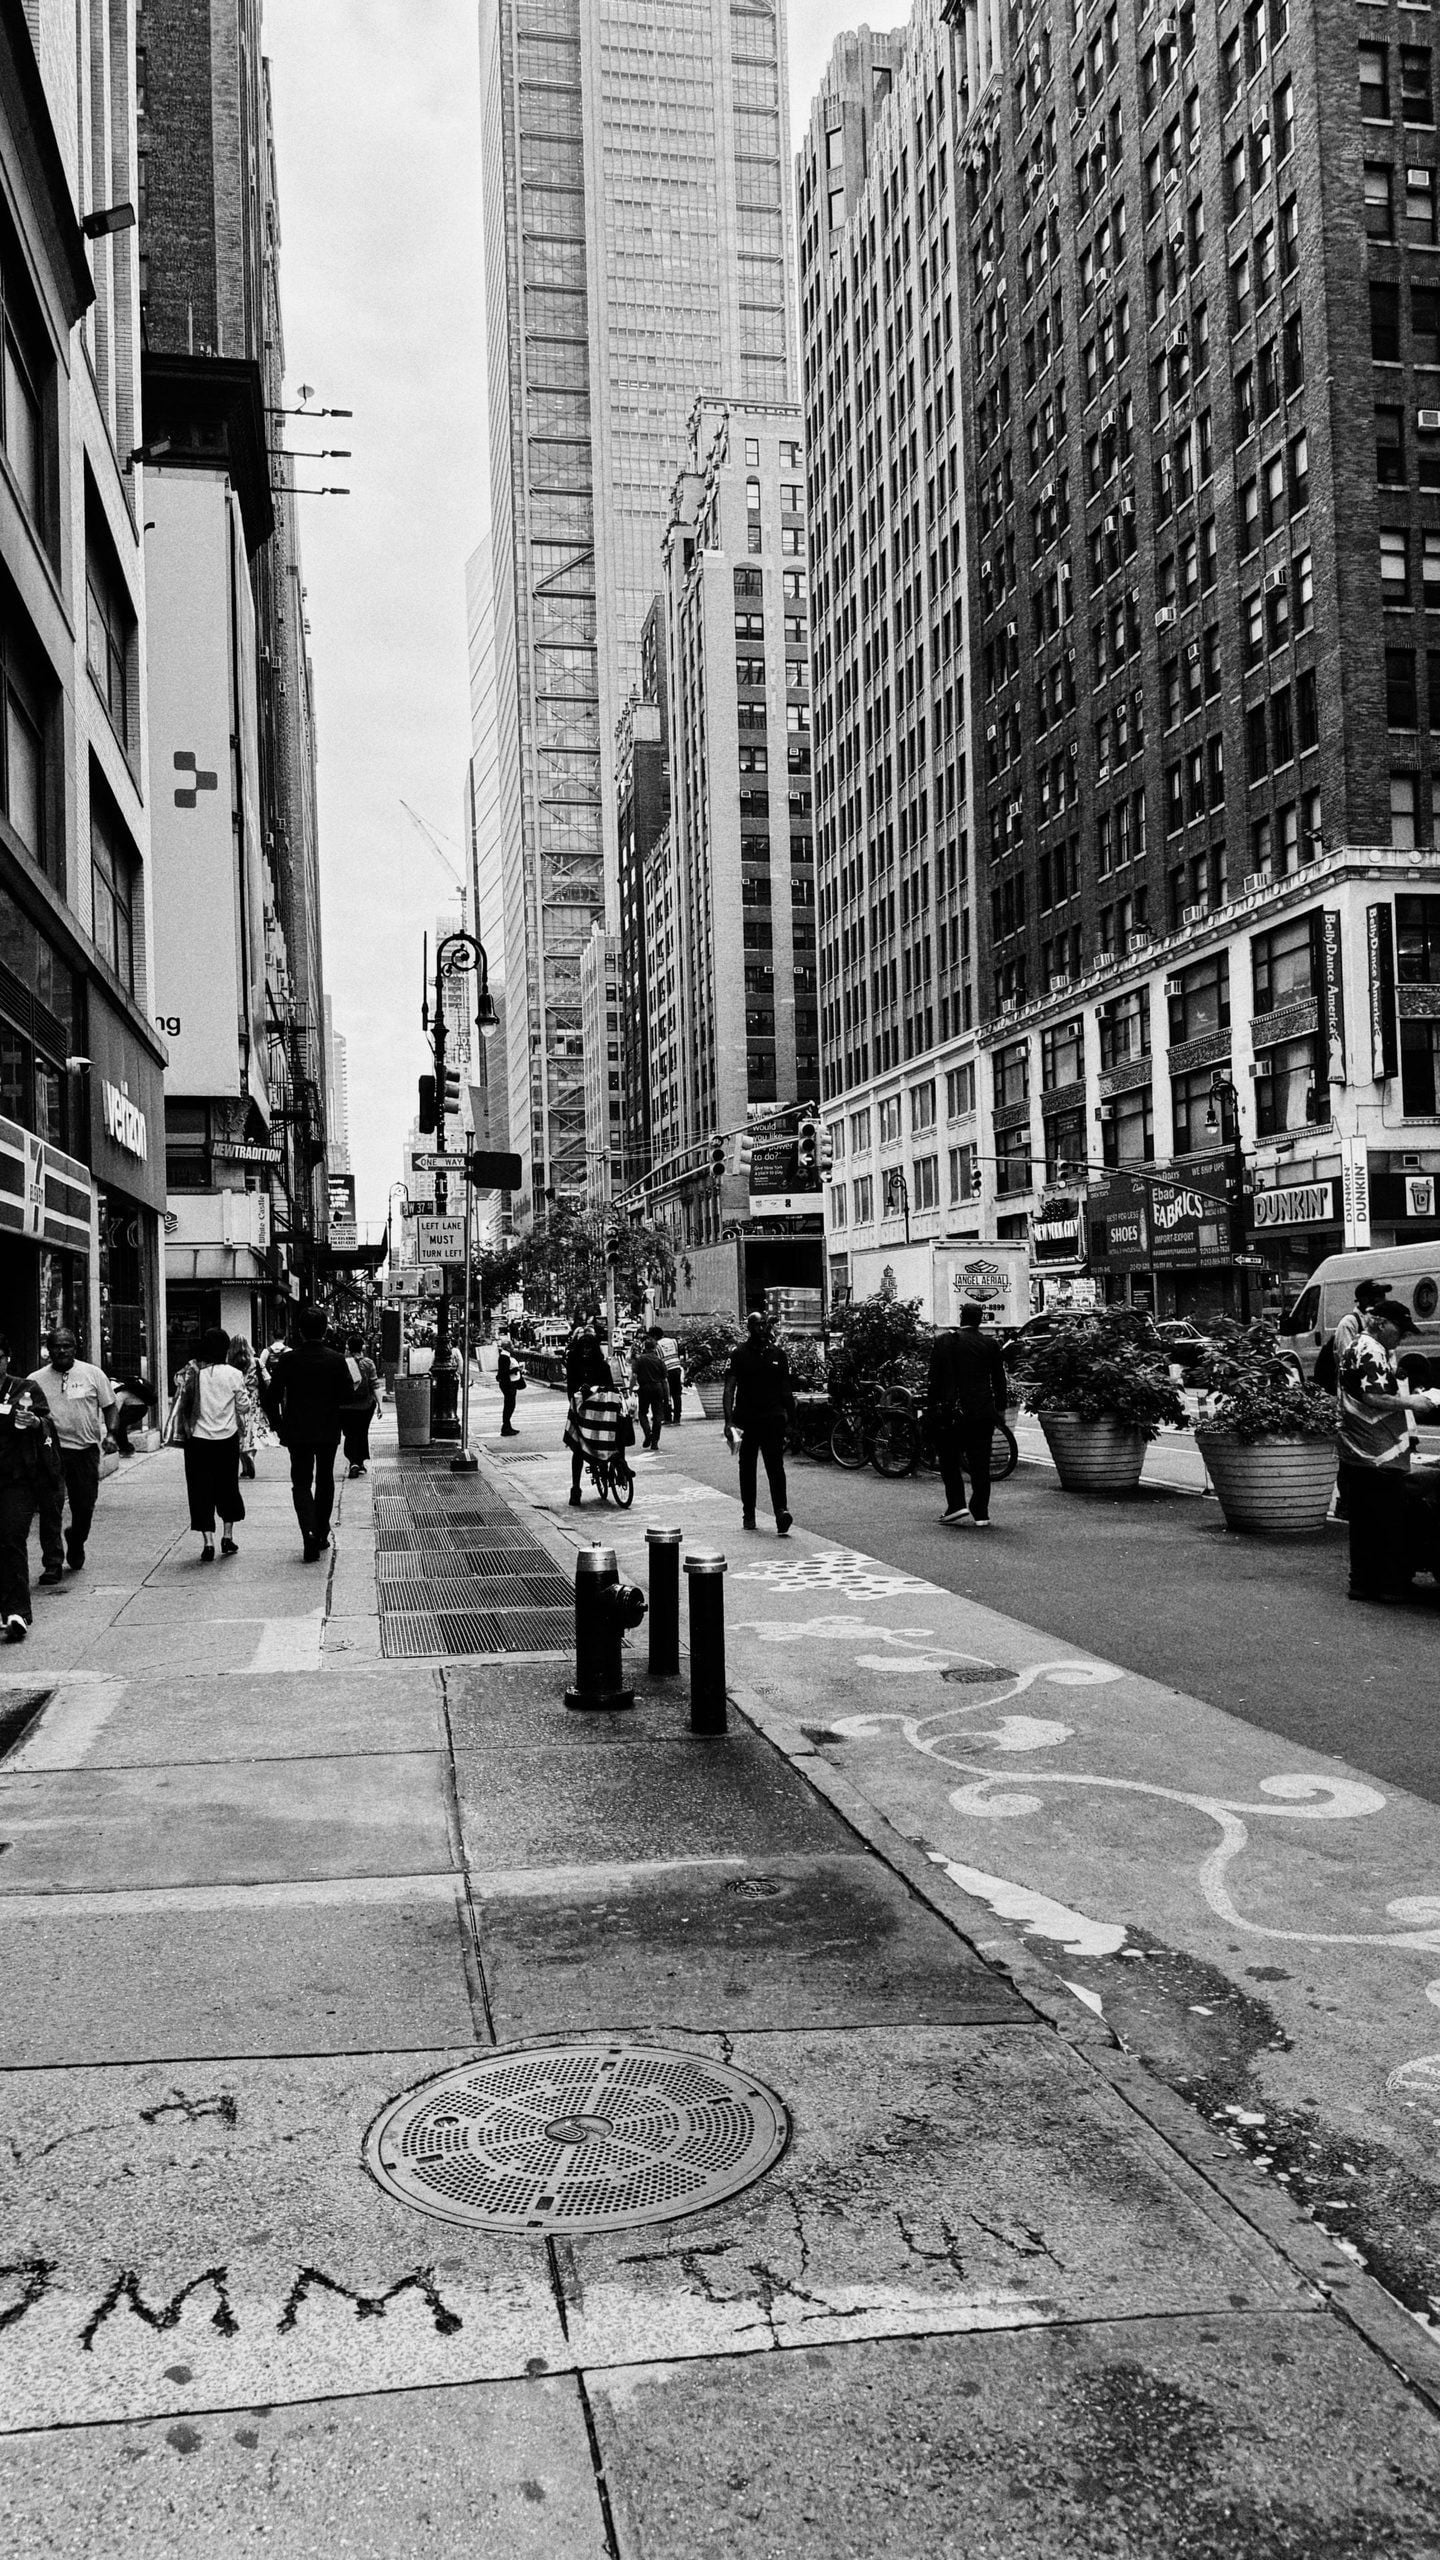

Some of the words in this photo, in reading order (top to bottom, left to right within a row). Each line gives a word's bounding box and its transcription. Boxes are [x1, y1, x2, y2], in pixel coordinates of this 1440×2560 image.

[1323, 914, 1338, 982] BellyDance
[1369, 908, 1379, 978] BellyDance
[1327, 984, 1339, 1039] America
[1372, 980, 1381, 1032] America
[102, 1080, 147, 1161] verizon
[753, 1122, 777, 1131] would
[420, 1158, 437, 1166] ONE
[445, 1158, 462, 1166] WAY
[754, 1153, 762, 1161] to
[1152, 1187, 1175, 1201] Ebad
[1354, 1162, 1367, 1222] DUNKIN'
[408, 1202, 415, 1214] W
[416, 1202, 426, 1214] 37
[1153, 1191, 1203, 1228] FABRICS
[1254, 1187, 1328, 1224] DUNKIN'
[421, 1222, 439, 1230] LEFT
[442, 1222, 461, 1230] LANE
[430, 1235, 454, 1244] MUST
[1110, 1225, 1138, 1243] SHOES
[1154, 1232, 1194, 1244] IMPORT-EXPORT
[445, 1249, 462, 1257] LEFT
[957, 1275, 978, 1284] ANGEL
[981, 1275, 1006, 1284] AERIAL
